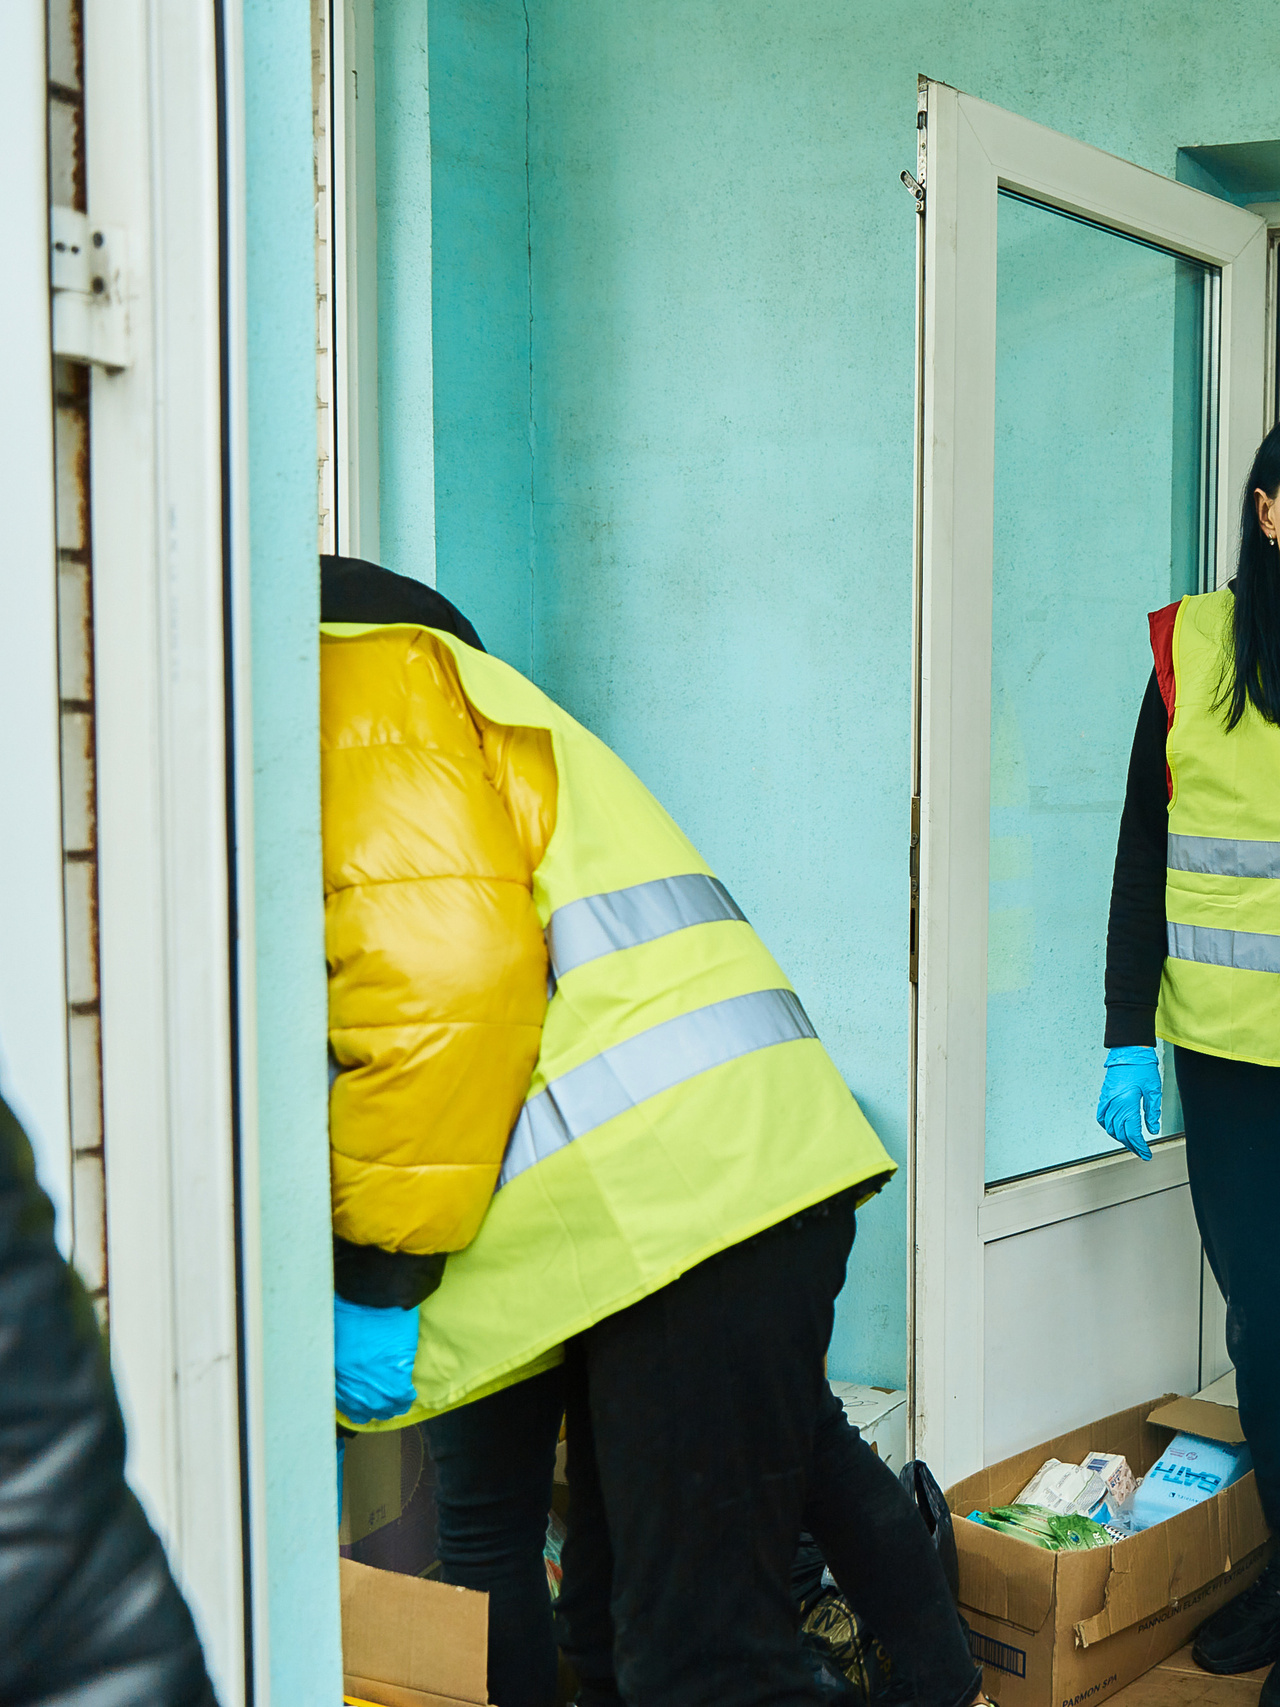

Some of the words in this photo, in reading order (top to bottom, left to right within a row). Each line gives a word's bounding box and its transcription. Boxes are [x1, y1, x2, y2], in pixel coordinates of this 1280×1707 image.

[1150, 1461, 1222, 1494] BATH
[1137, 1604, 1182, 1633] PANNOLINI
[1062, 1683, 1101, 1707] PARMON
[1102, 1673, 1117, 1689] SPA
